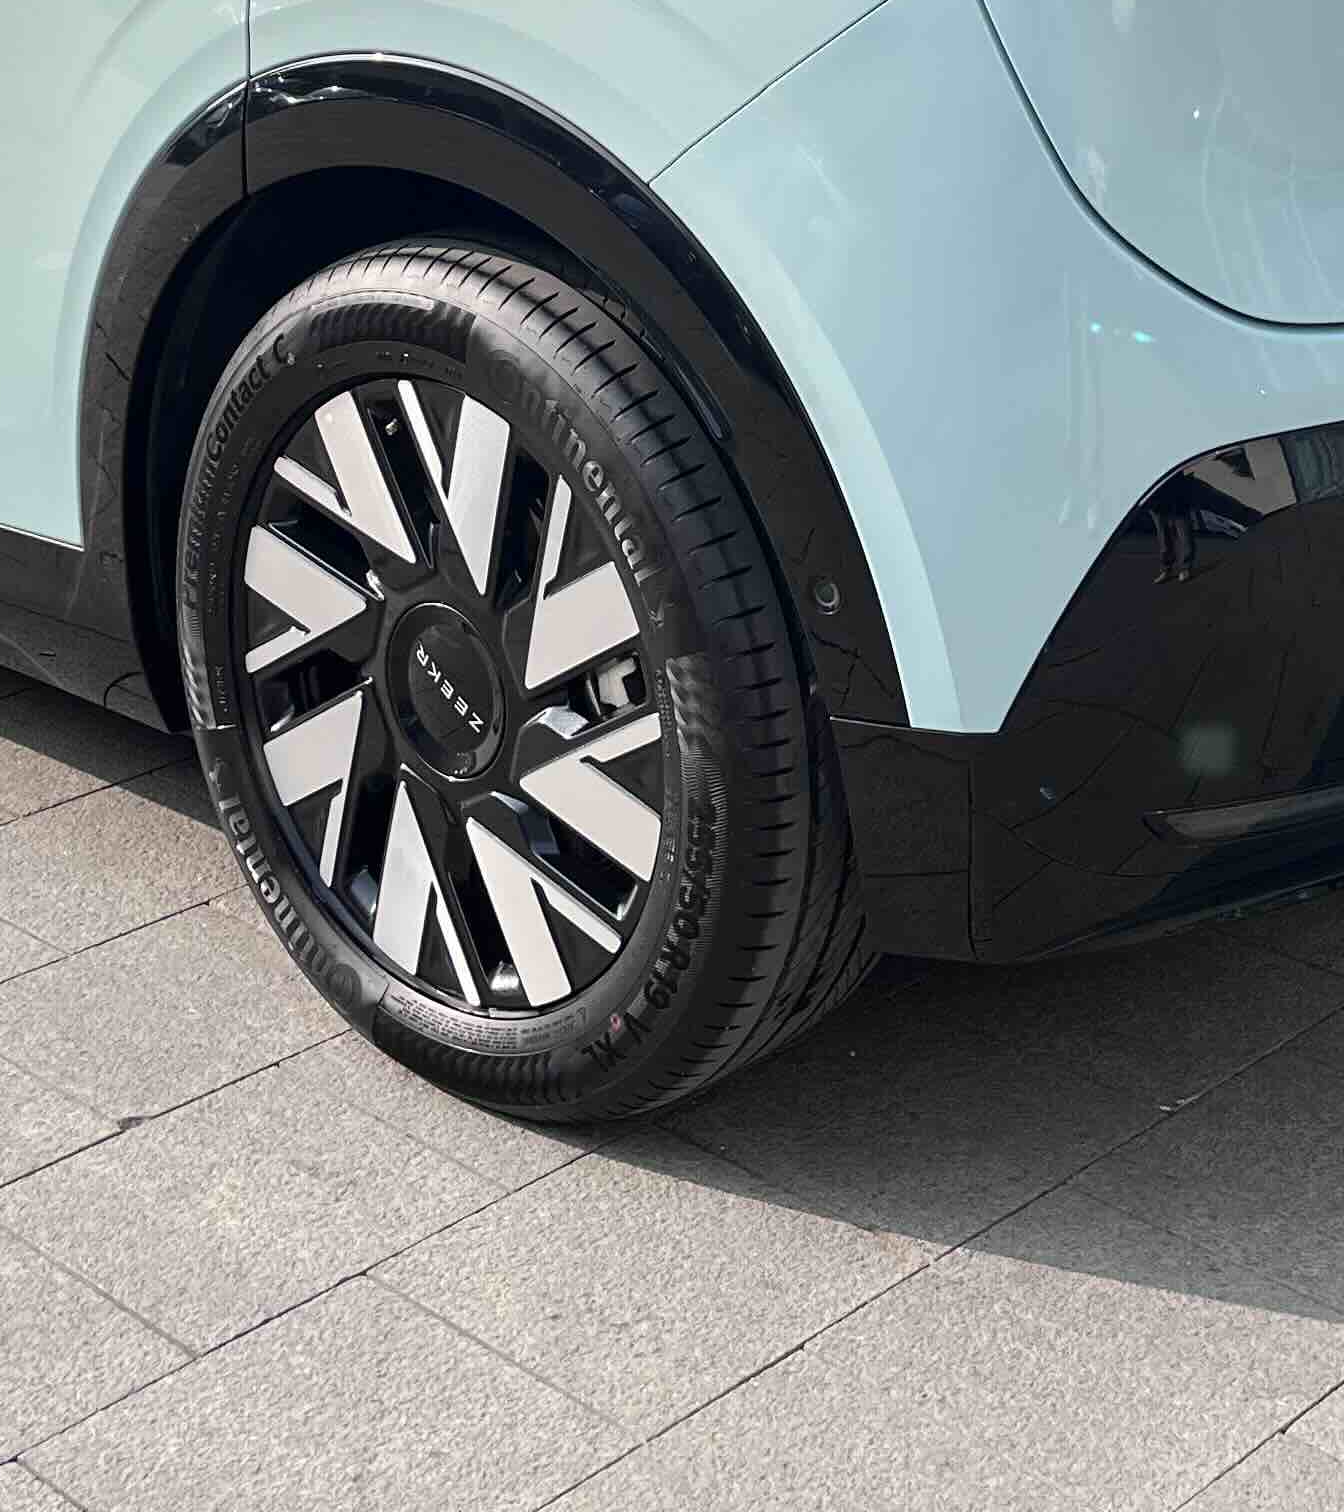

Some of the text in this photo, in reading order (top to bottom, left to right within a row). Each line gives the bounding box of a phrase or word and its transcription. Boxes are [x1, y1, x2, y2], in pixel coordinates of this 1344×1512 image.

[484, 348, 663, 587] Continental
[416, 638, 485, 734] ZEEKR
[218, 793, 362, 1015] Continental
